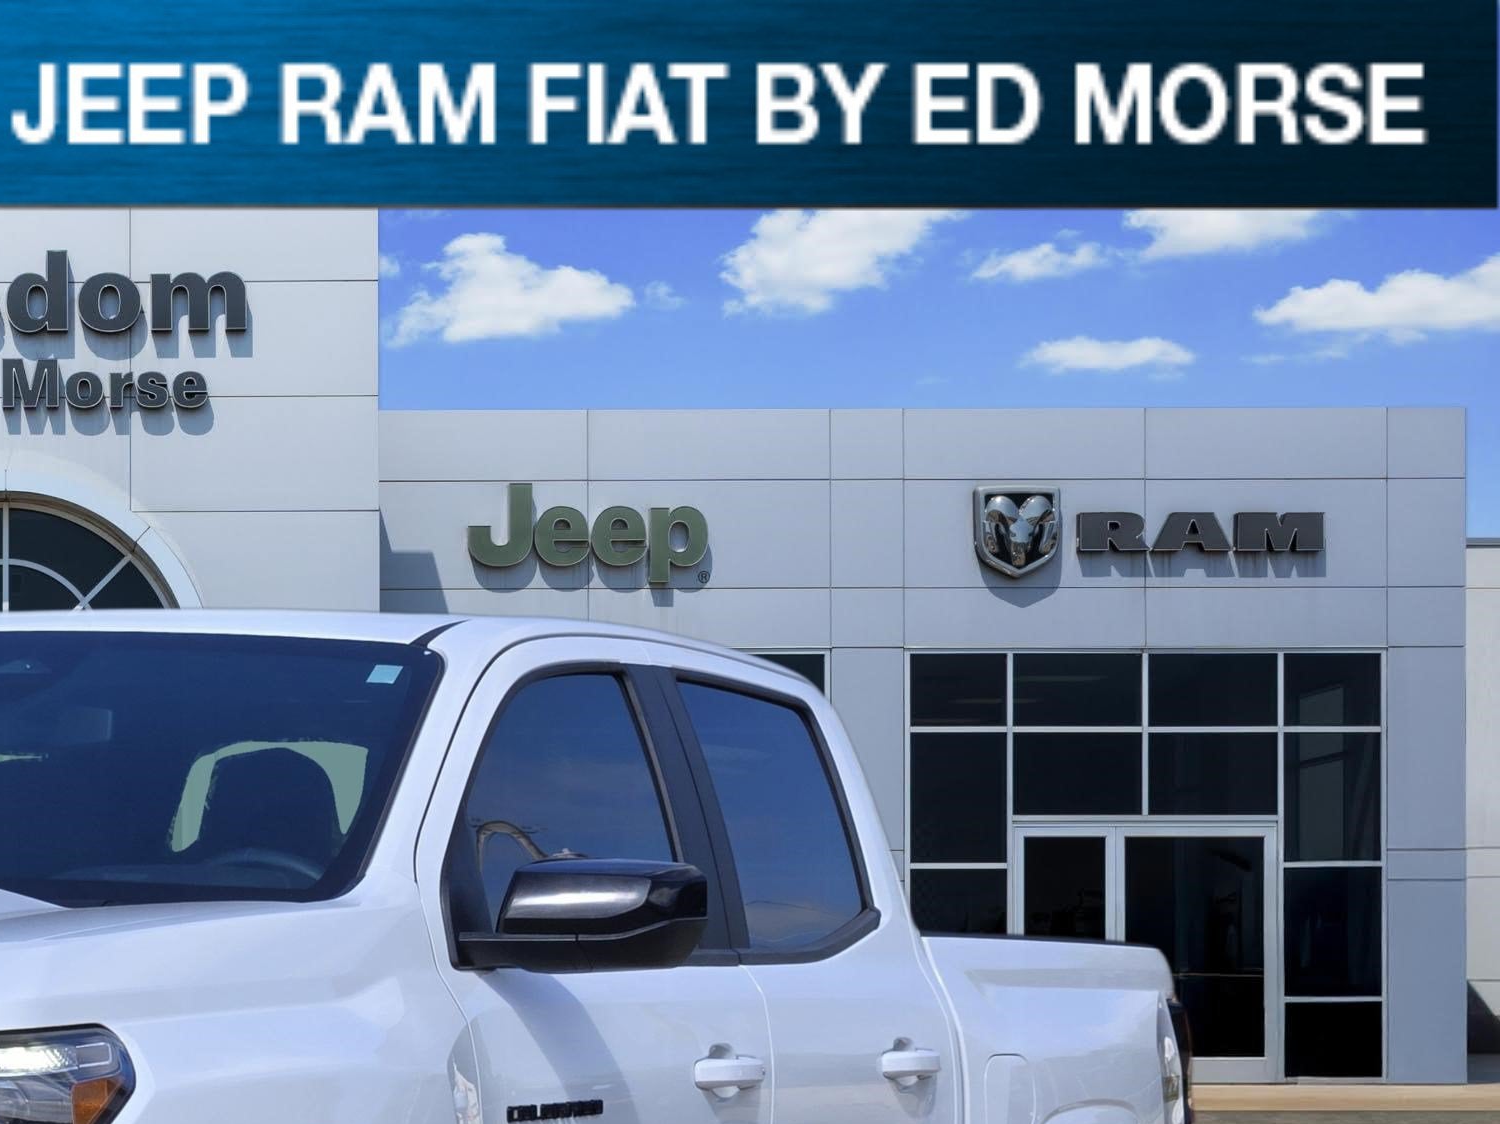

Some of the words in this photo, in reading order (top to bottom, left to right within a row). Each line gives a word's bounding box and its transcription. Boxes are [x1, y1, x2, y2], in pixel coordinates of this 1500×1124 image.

[1, 357, 209, 409] Morse
[467, 482, 709, 584] Jeep
[1076, 511, 1325, 552] RAM
